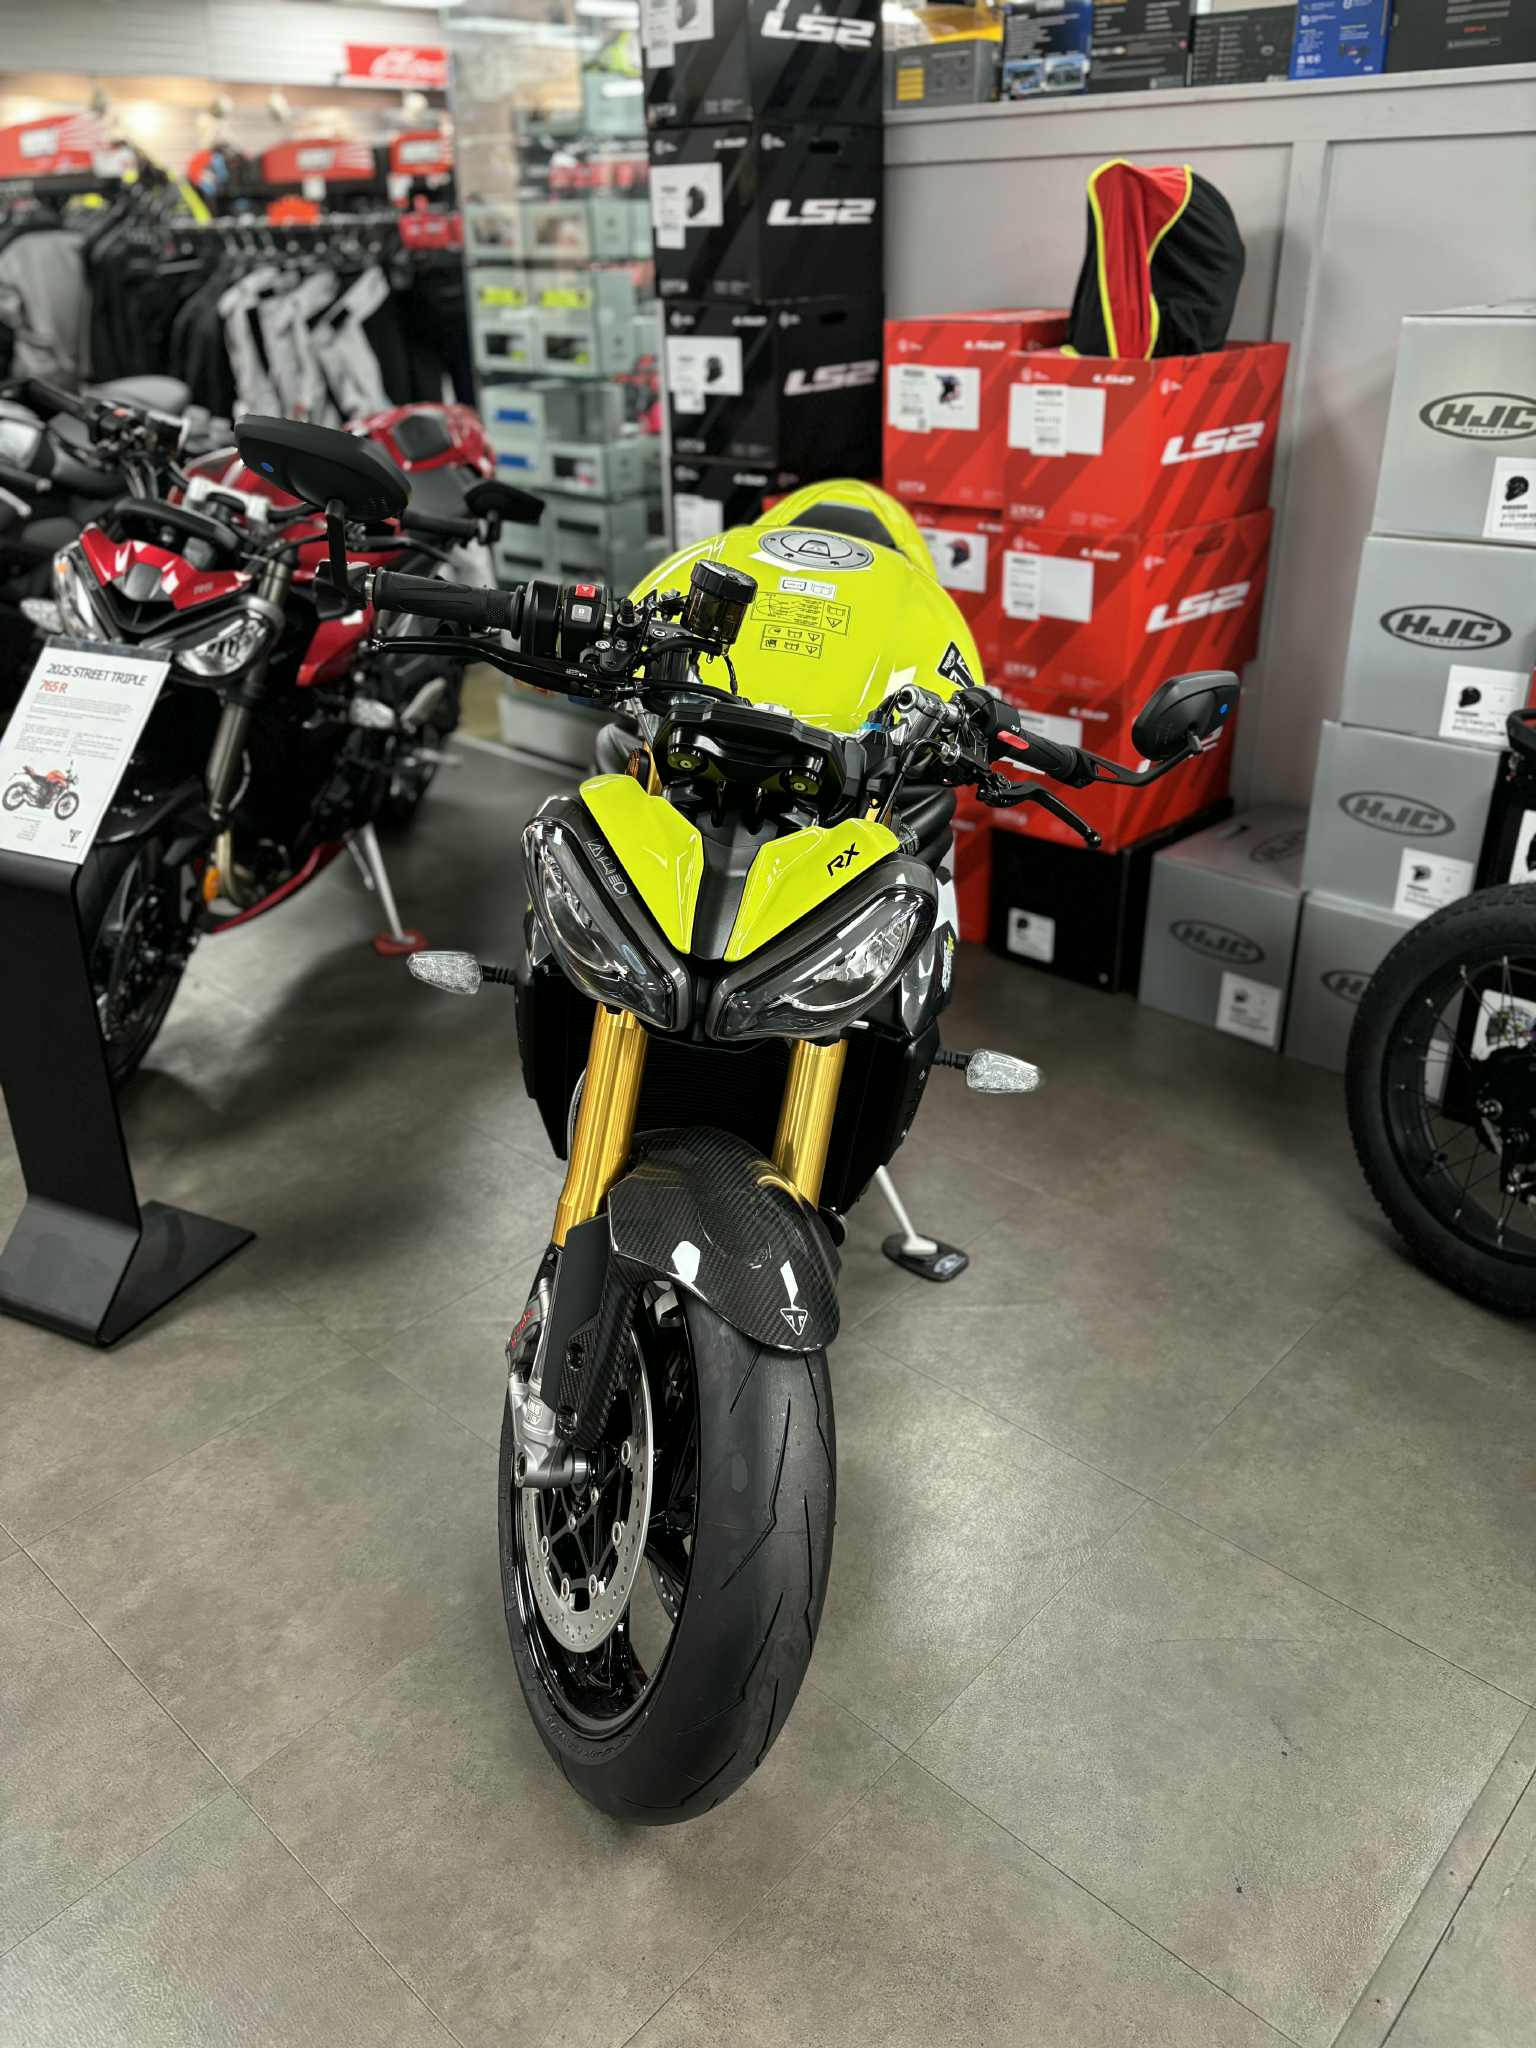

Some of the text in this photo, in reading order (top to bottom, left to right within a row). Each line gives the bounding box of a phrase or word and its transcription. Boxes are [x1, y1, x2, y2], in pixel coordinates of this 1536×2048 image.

[761, 8, 876, 48] LS2
[767, 198, 877, 227] LS2
[784, 359, 880, 397] LS2
[1435, 403, 1536, 430] HJC
[1161, 421, 1265, 466] LS2
[1146, 582, 1251, 634] LS2
[1395, 613, 1496, 643] HJC
[40, 680, 68, 693] 765 R
[47, 664, 148, 686] 2025 STREET TRIPLE
[1353, 798, 1441, 831] HJC
[826, 842, 861, 877] RX
